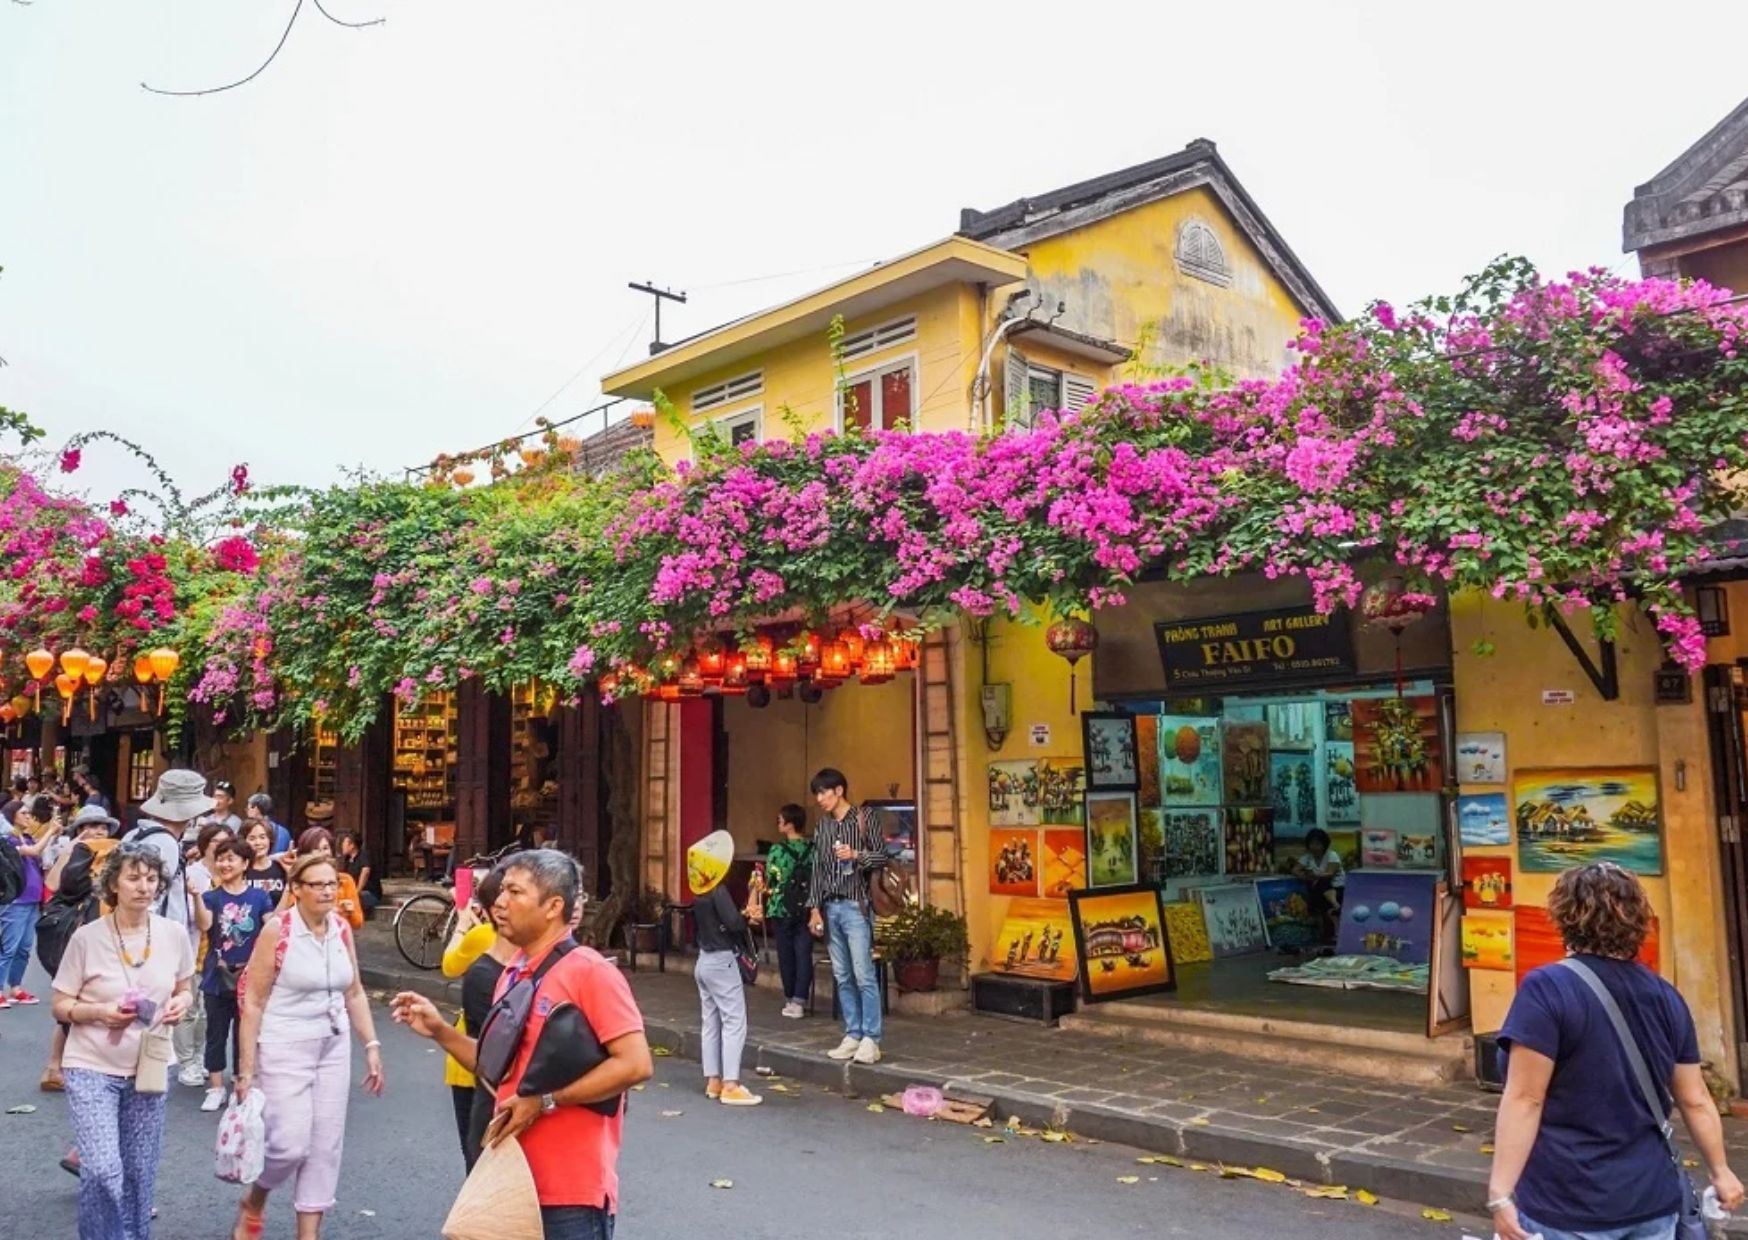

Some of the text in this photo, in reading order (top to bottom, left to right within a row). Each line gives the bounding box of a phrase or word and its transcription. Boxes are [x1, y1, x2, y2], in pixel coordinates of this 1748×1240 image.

[1201, 622, 1239, 638] TRANH
[1263, 613, 1330, 632] ART GALLERY
[1201, 634, 1296, 665] FAIFO
